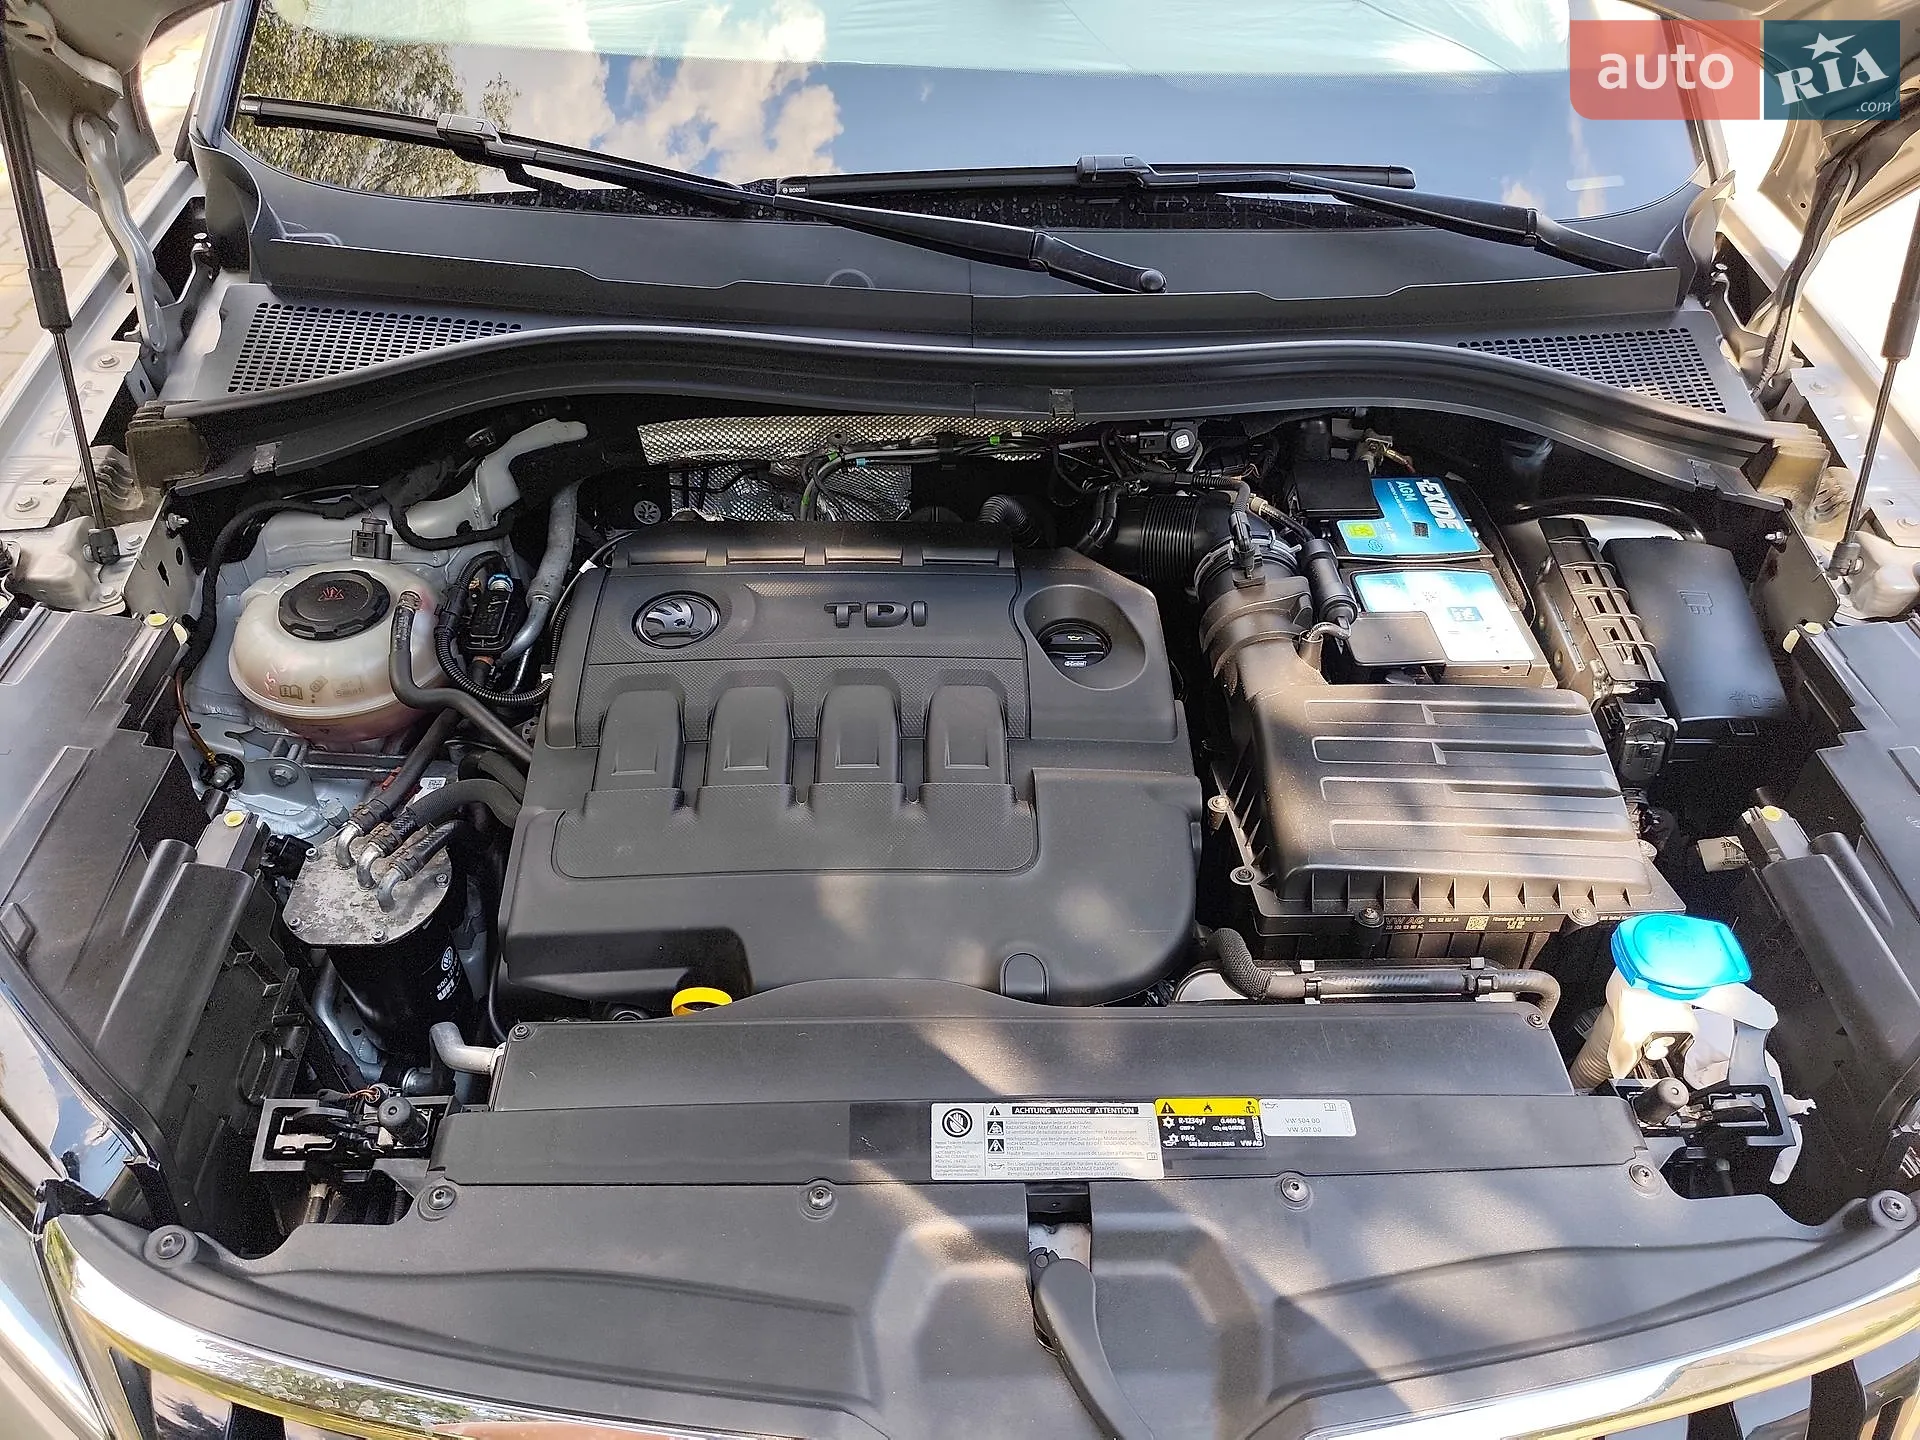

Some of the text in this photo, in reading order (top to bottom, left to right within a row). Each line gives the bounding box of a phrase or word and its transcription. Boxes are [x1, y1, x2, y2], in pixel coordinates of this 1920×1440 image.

[1395, 480, 1418, 502] AGM
[1415, 479, 1463, 532] EXIDE
[824, 601, 928, 629] TDI
[1385, 916, 1405, 924] VW
[1406, 916, 1425, 924] AG
[1180, 1134, 1196, 1142] PAG
